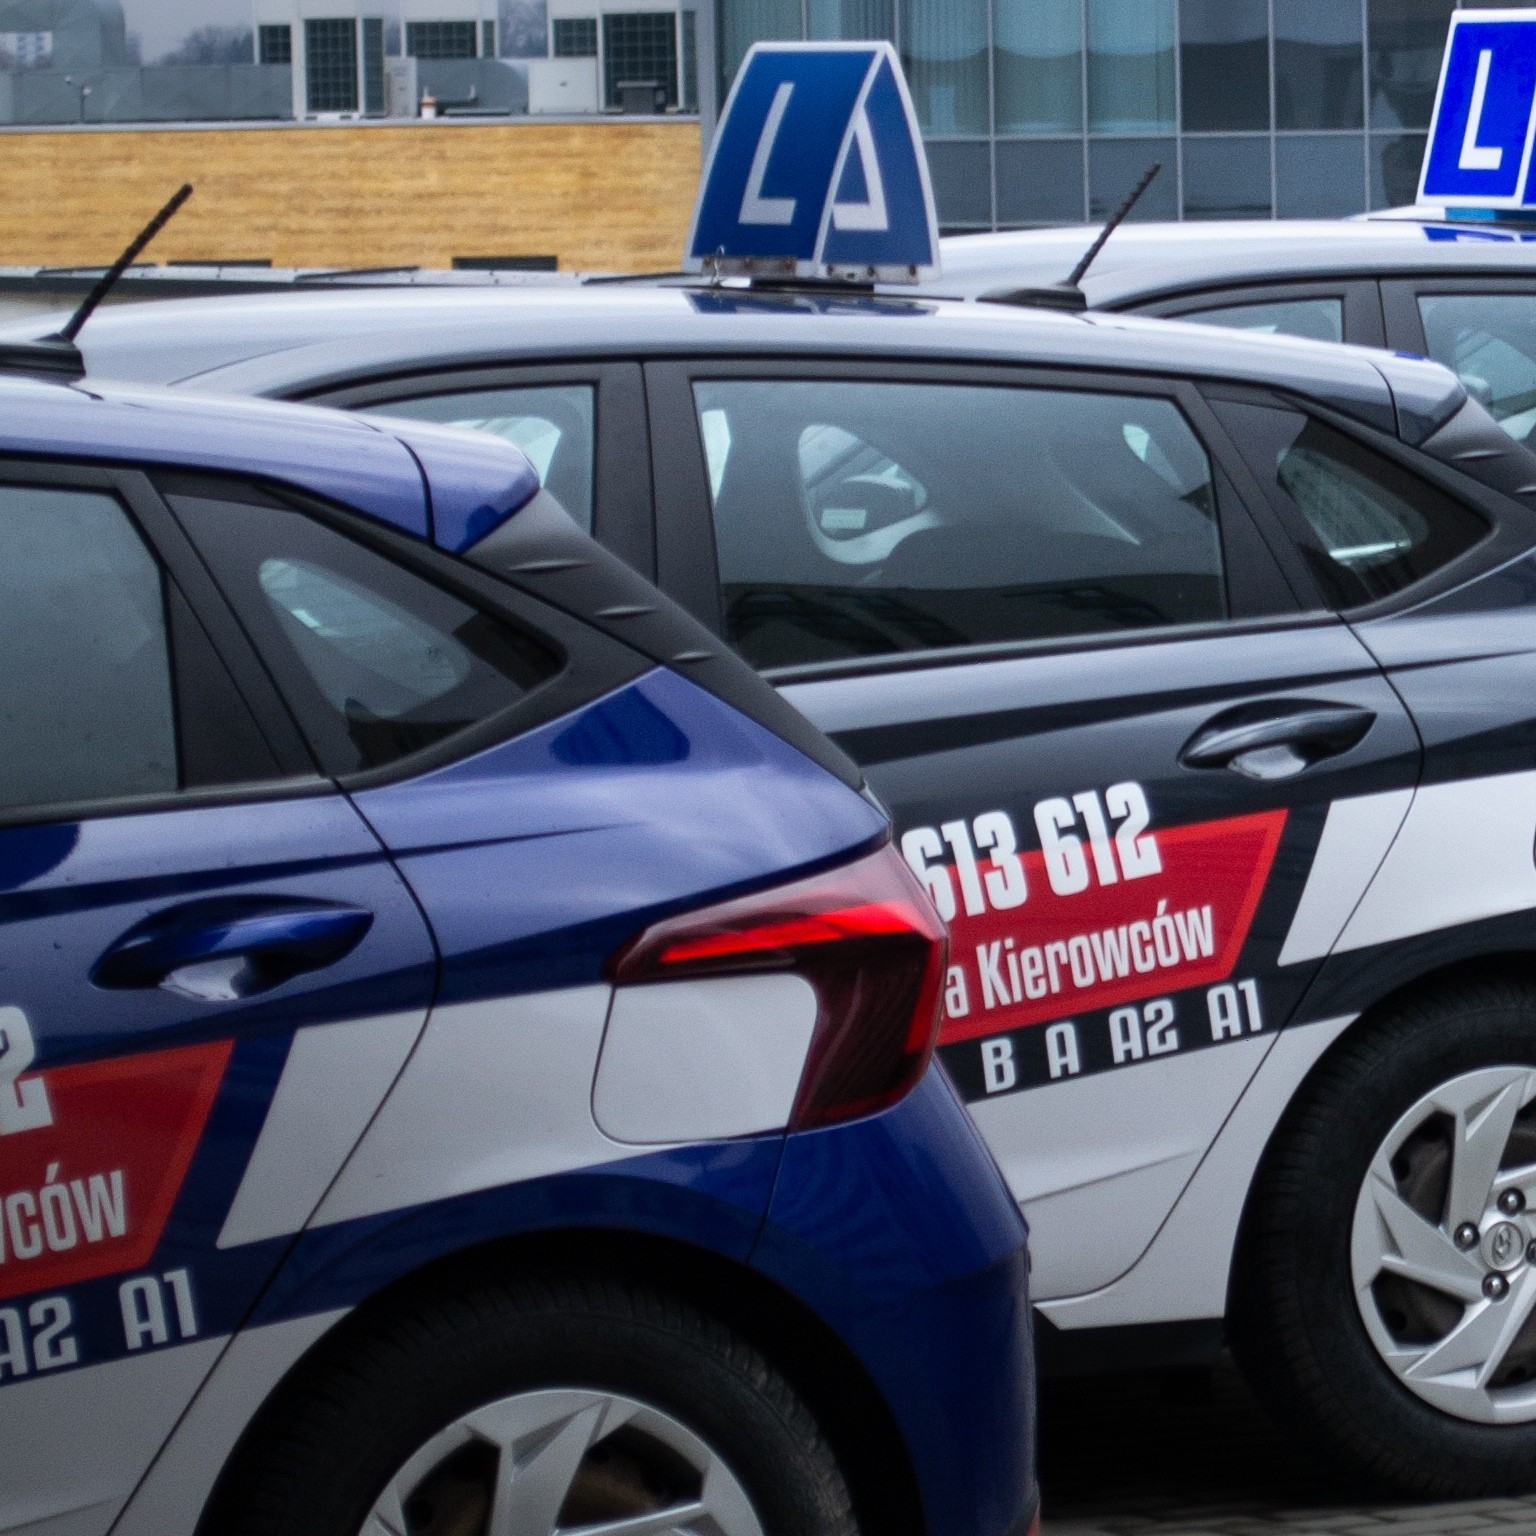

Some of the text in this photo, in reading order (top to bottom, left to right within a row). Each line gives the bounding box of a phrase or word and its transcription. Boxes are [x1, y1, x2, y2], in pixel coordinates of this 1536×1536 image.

[738, 81, 796, 225] L
[1458, 49, 1502, 170] L
[901, 781, 1162, 923] 613 612
[941, 896, 1214, 1019] a Kierowców
[981, 978, 1263, 1094] B A A2 A1
[0, 1163, 126, 1263] ców
[118, 1268, 198, 1350] A1
